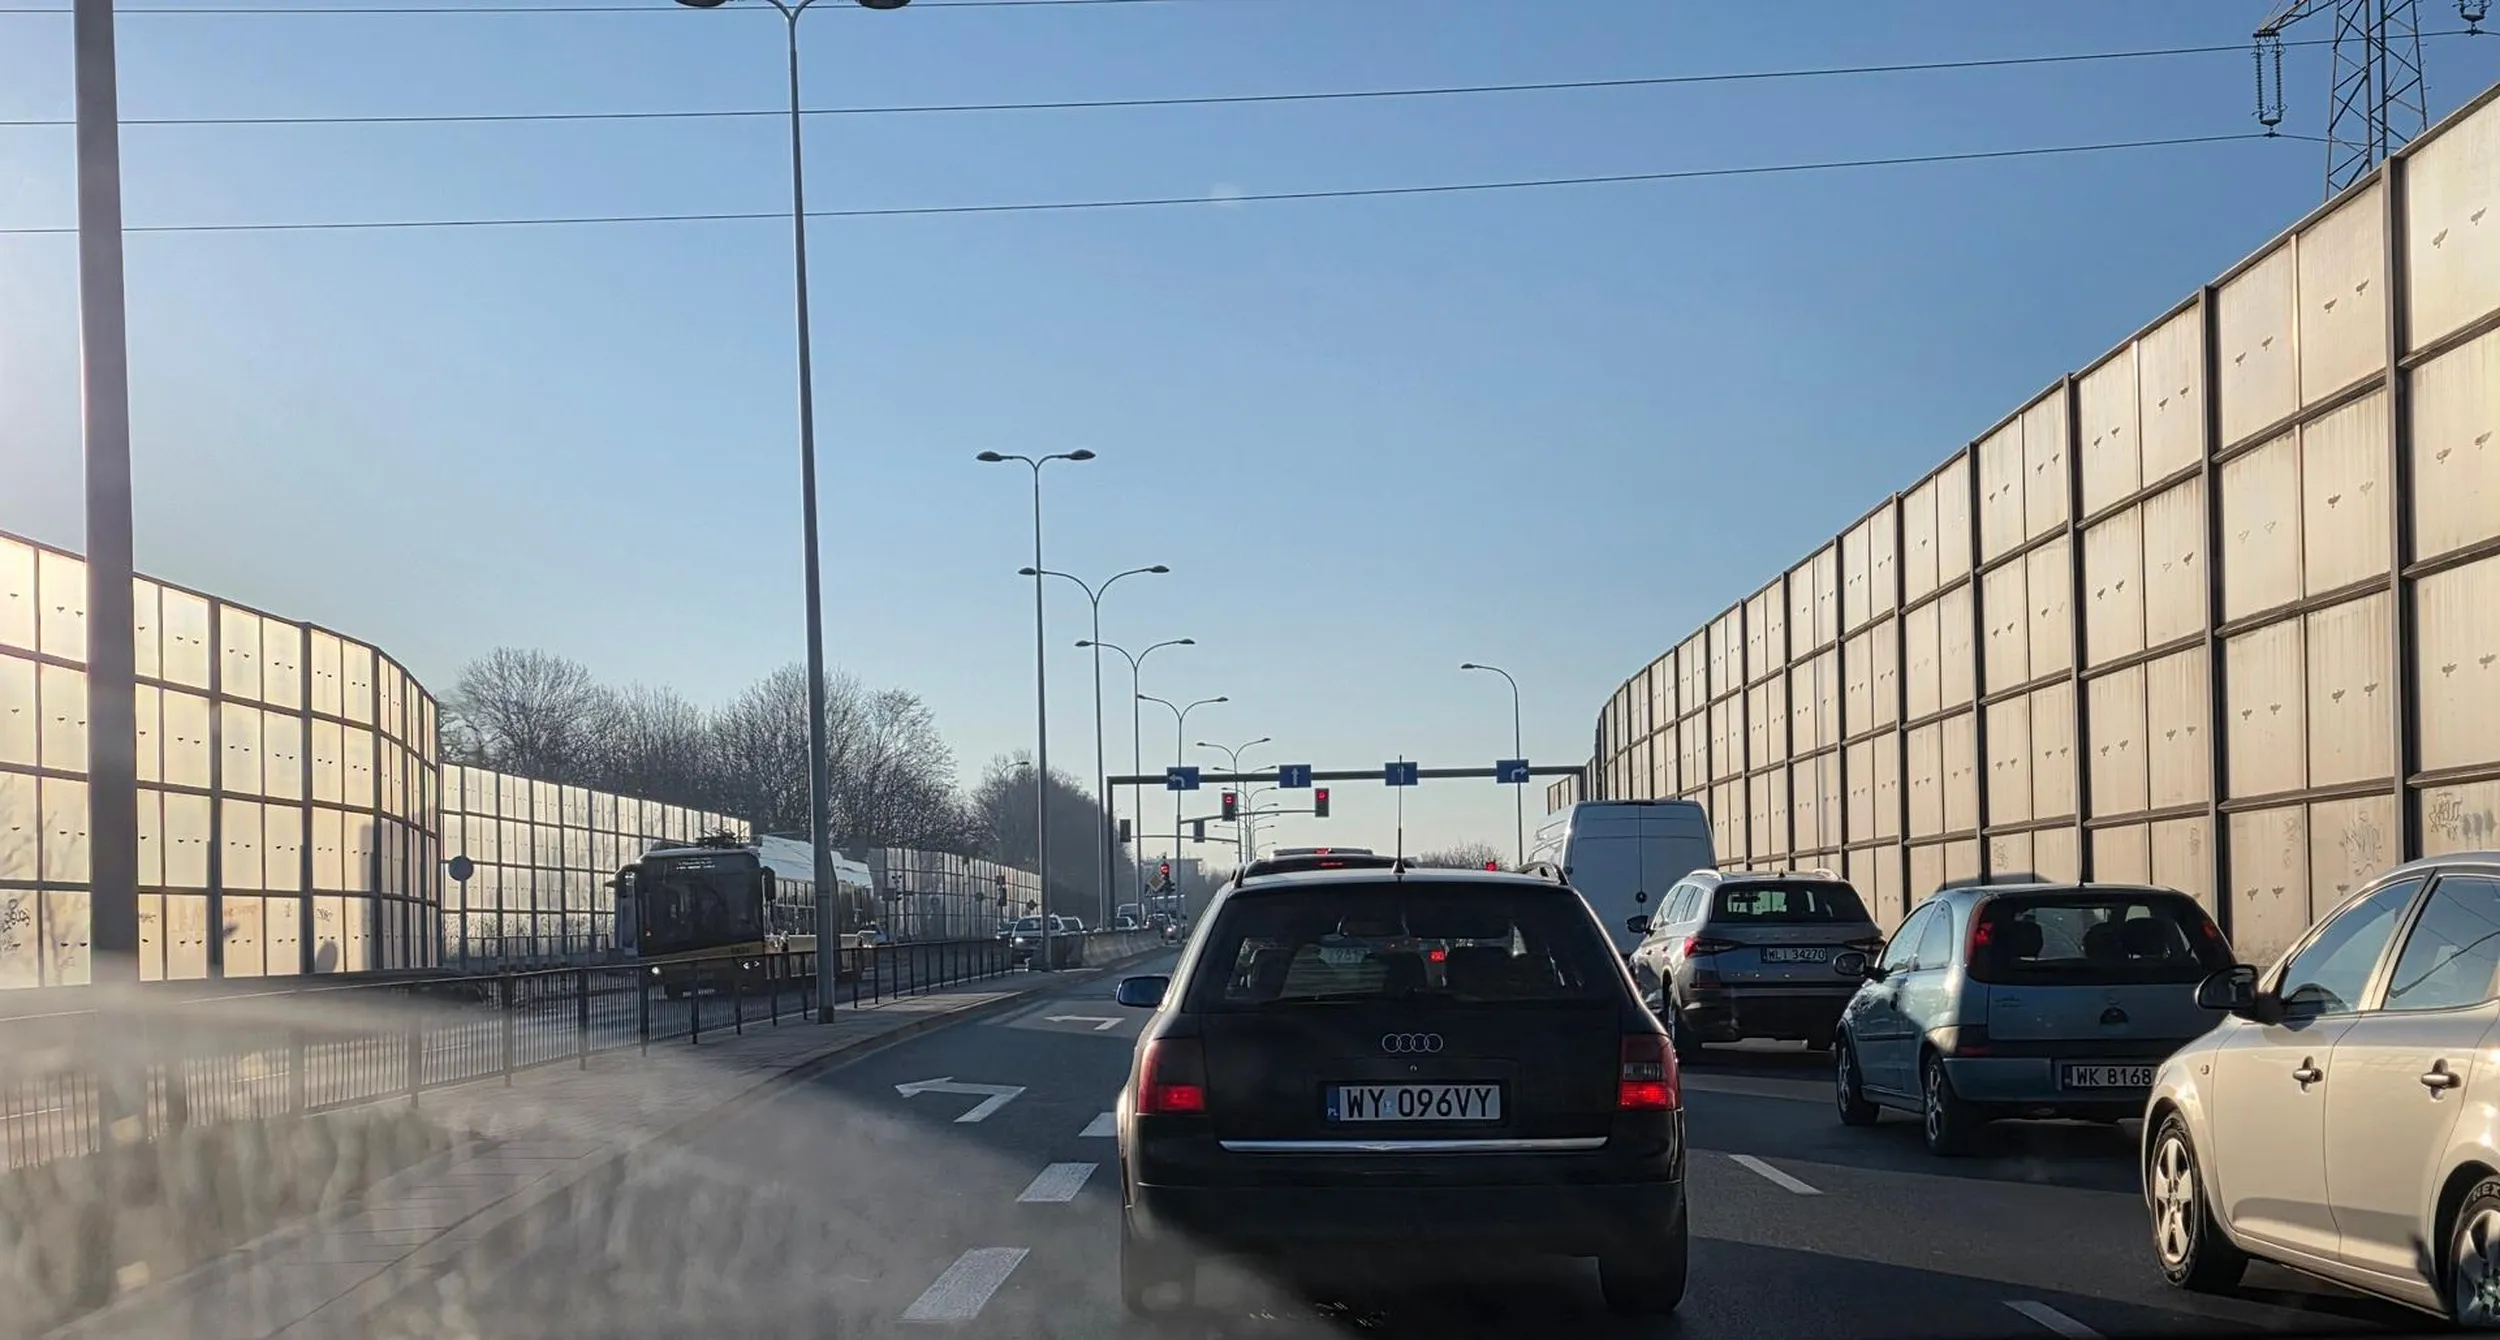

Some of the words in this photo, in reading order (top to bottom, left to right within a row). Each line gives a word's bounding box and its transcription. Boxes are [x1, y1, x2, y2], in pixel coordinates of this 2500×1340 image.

[2077, 1067, 2100, 1085] WK
[1346, 1088, 1385, 1118] WY
[1398, 1088, 1494, 1118] 096VY
